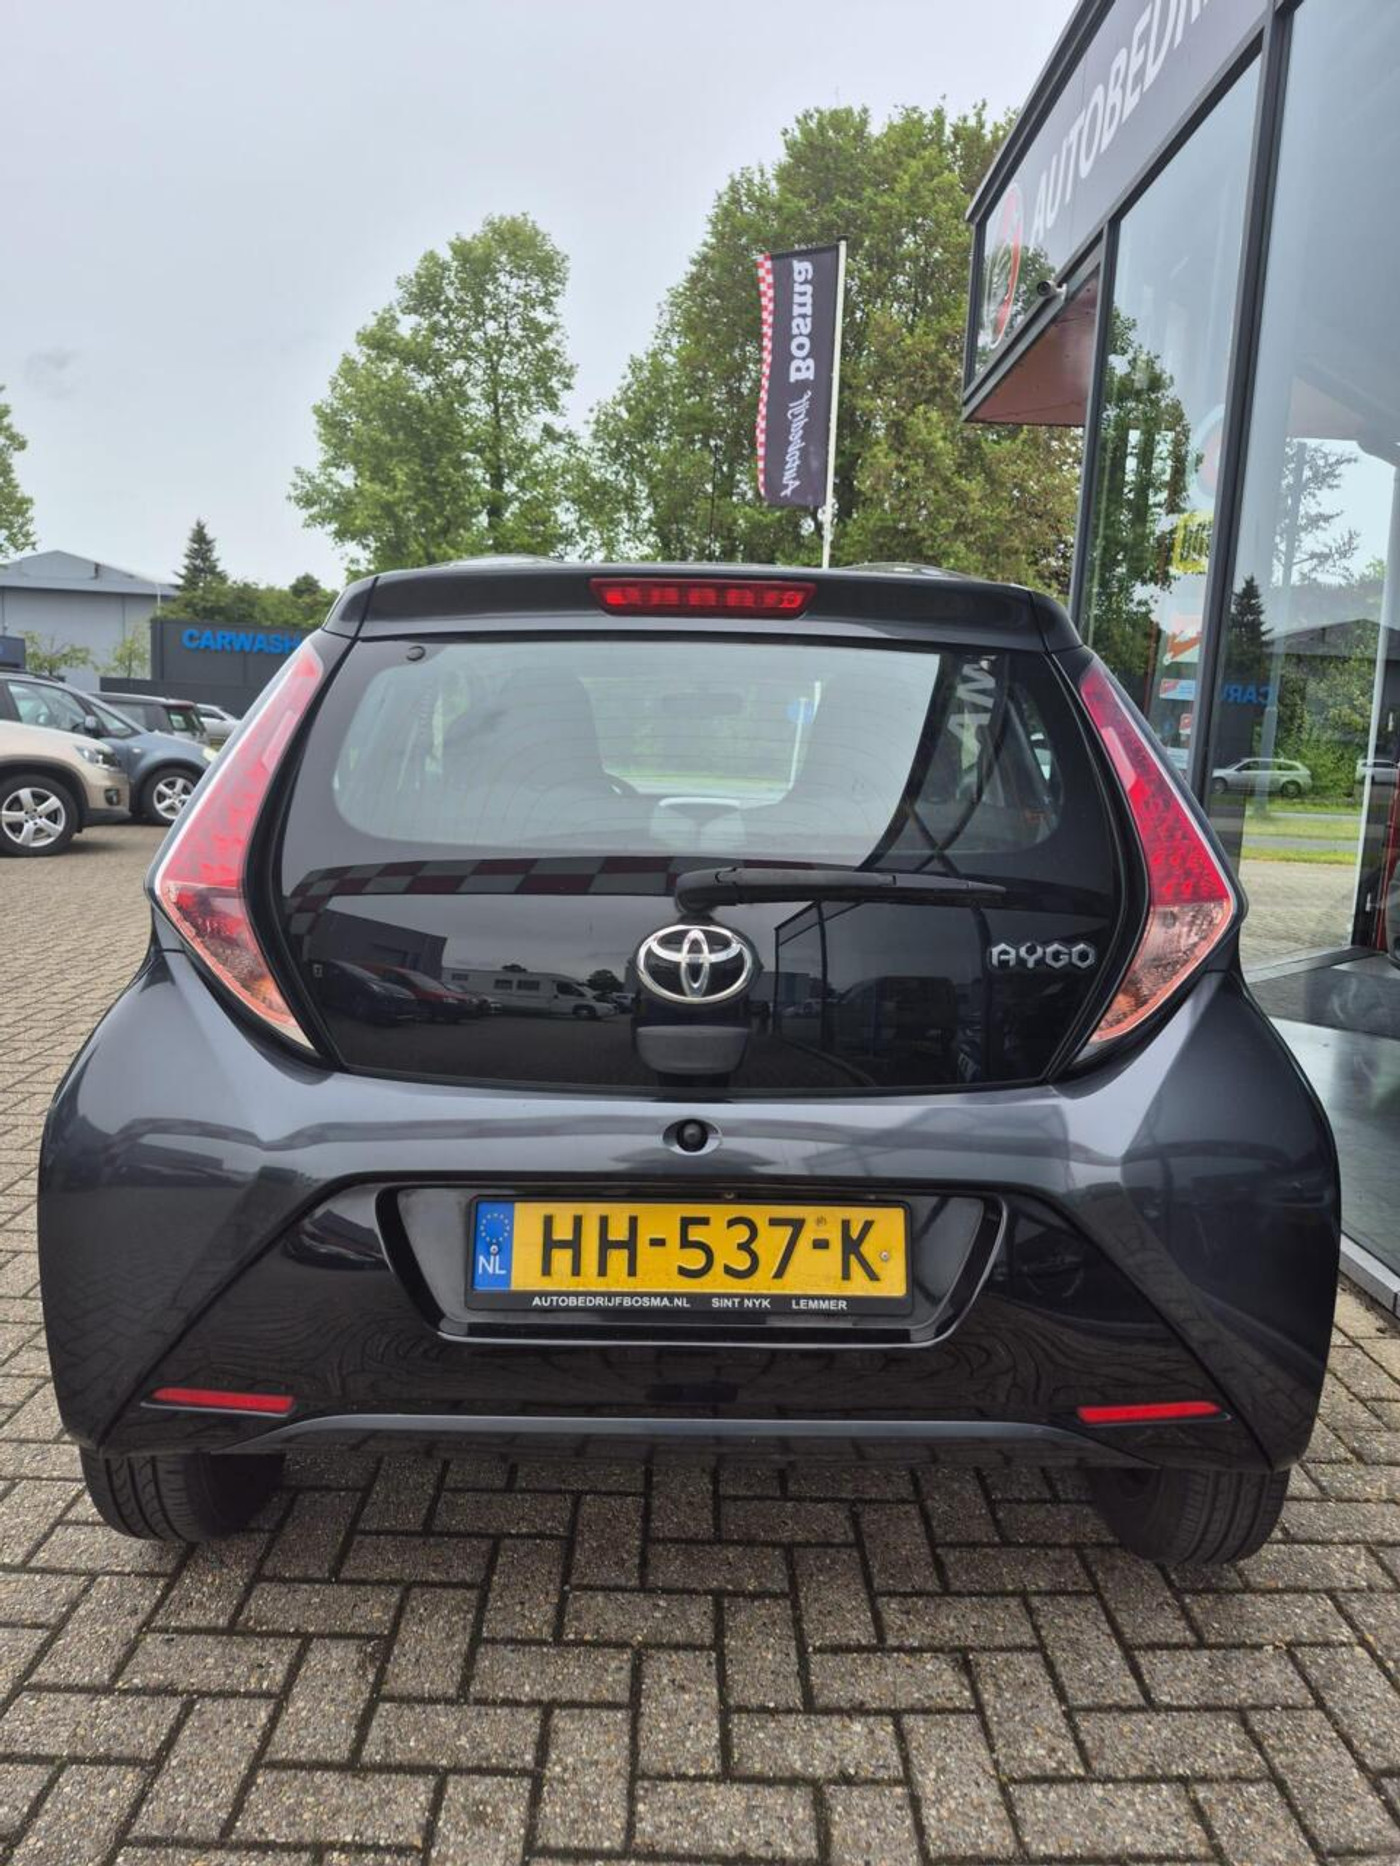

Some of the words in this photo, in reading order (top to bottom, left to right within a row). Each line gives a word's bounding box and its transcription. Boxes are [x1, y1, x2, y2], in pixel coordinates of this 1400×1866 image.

[991, 943, 1096, 969] AYGO
[541, 1214, 881, 1282] HH-537-K
[478, 1255, 507, 1275] NL
[532, 1296, 691, 1308] AUTOBEDRIJFBOSMA.NL
[711, 1297, 741, 1309] SINT
[744, 1298, 771, 1309] NYK
[791, 1299, 848, 1311] LEMMER
